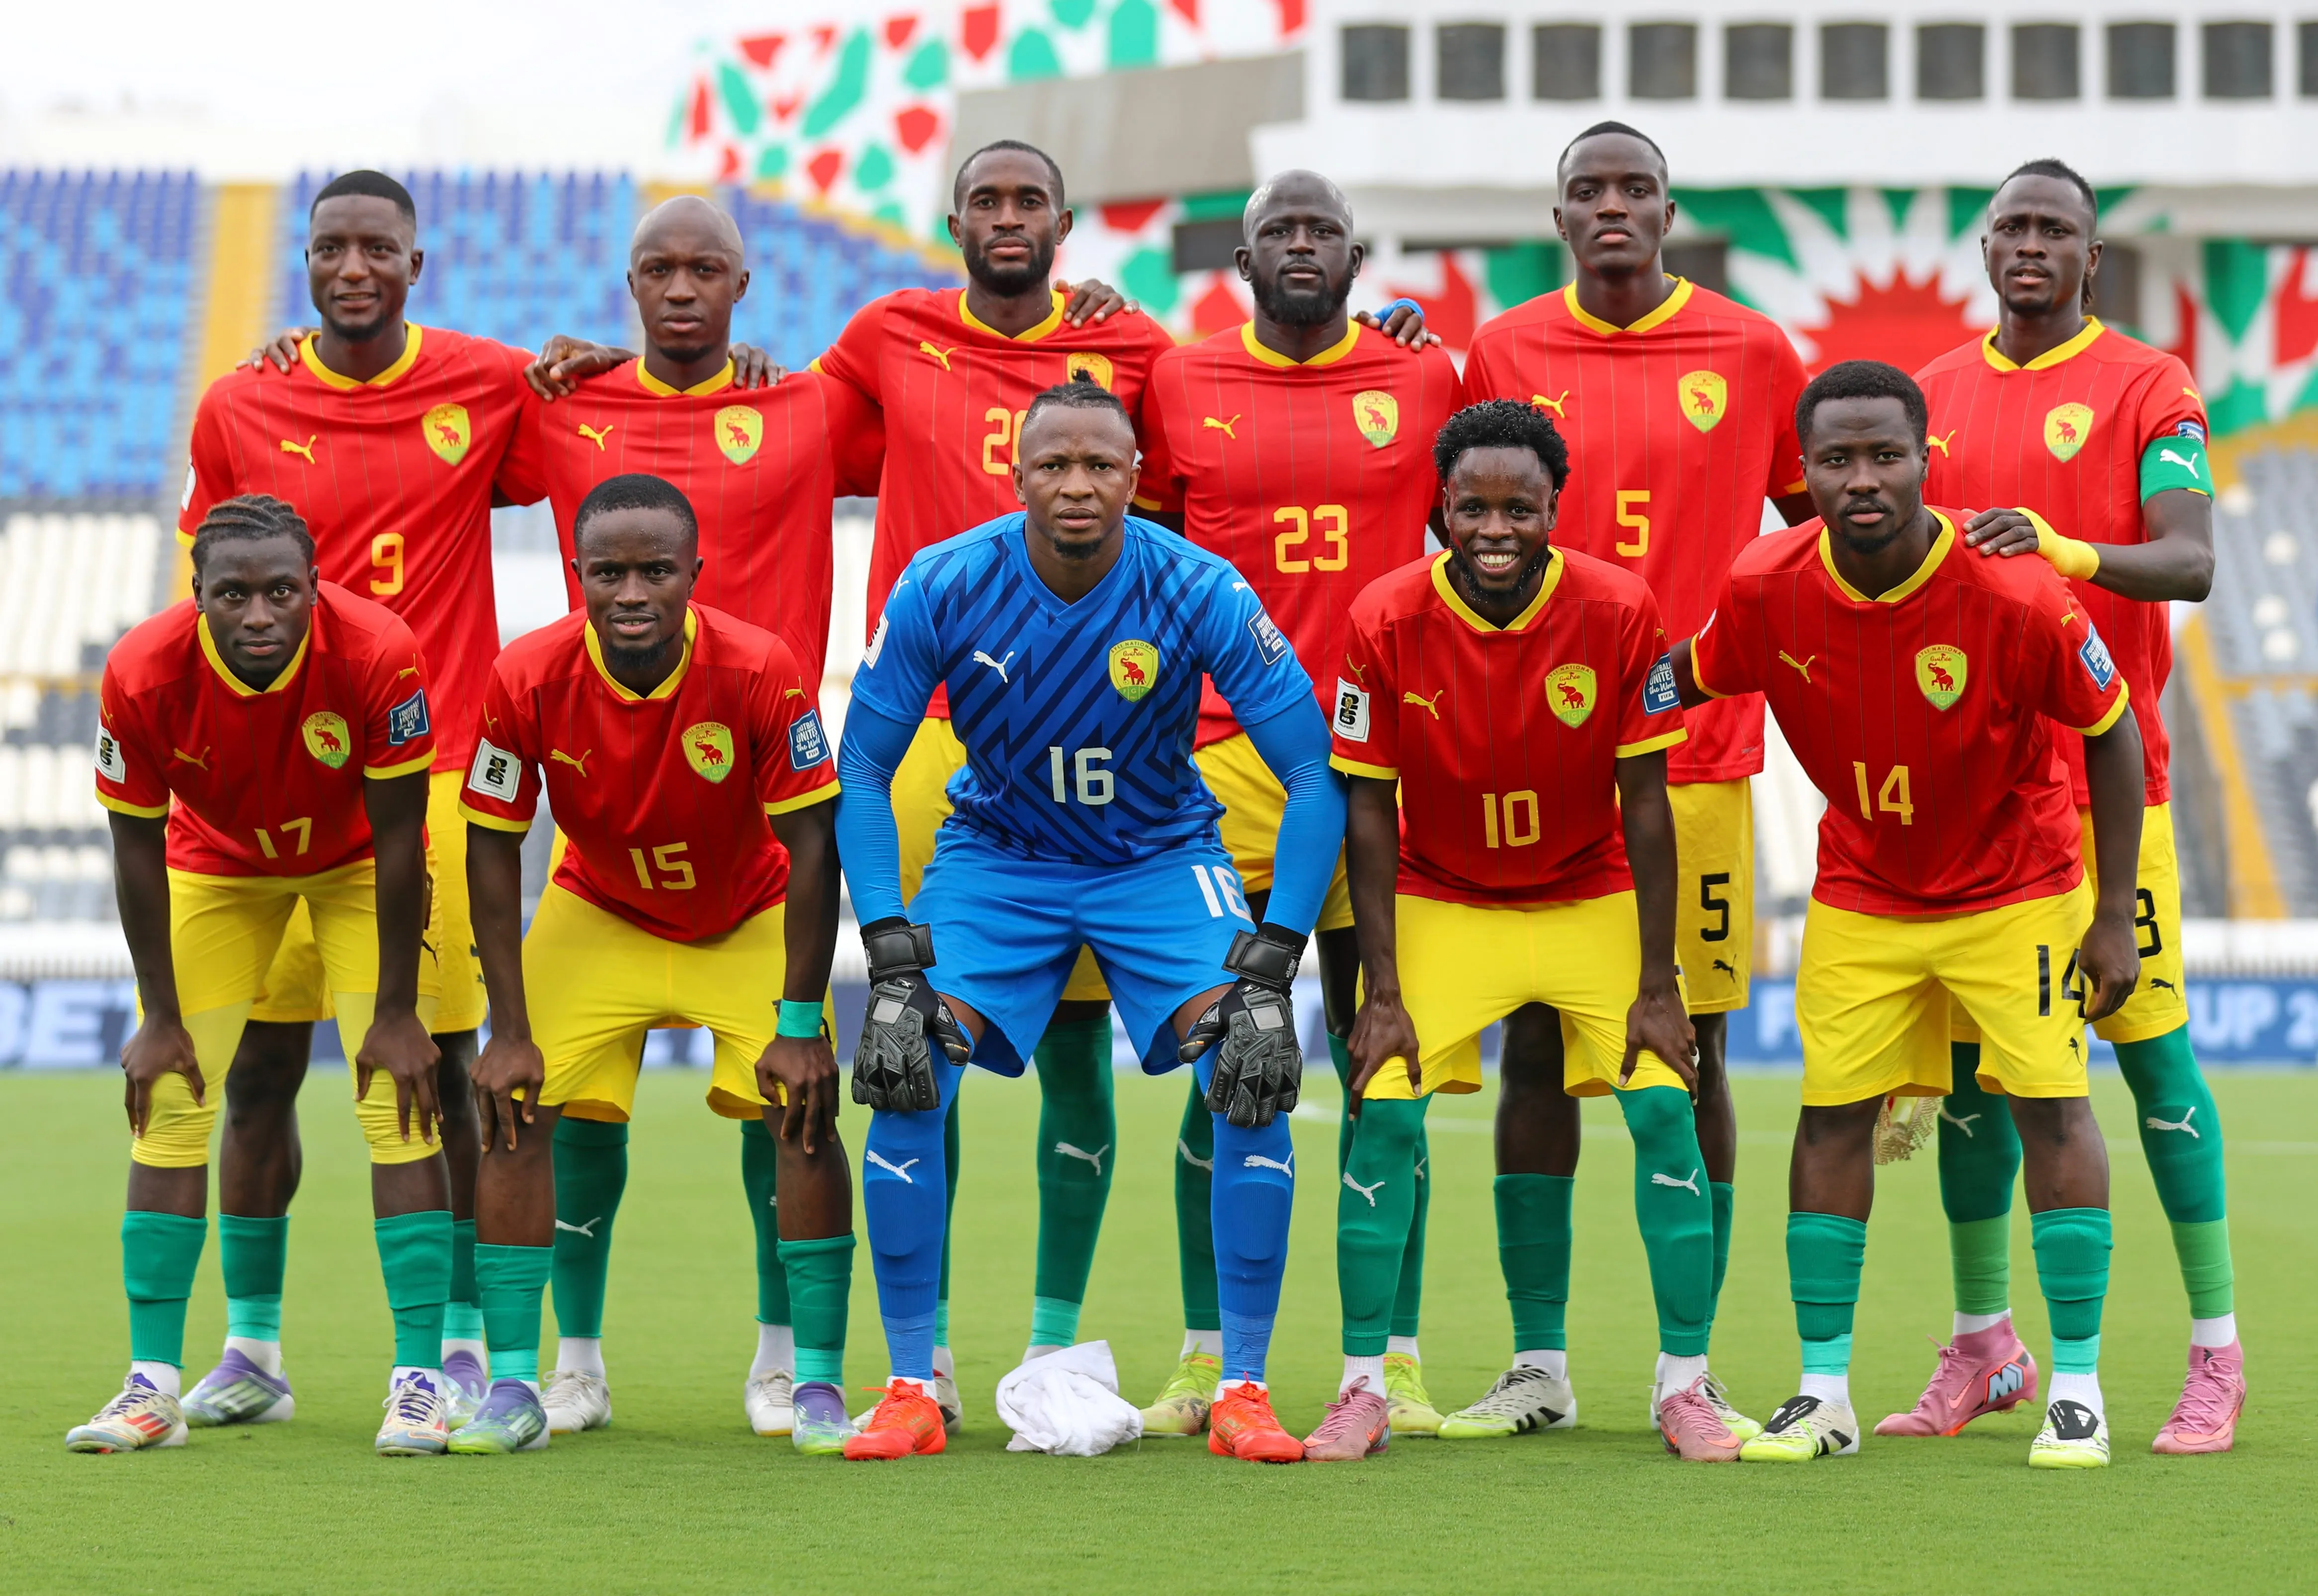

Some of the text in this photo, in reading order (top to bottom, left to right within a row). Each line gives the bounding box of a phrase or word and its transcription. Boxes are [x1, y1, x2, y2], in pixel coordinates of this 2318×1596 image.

[1273, 504, 1348, 573] 23
[1615, 490, 1651, 557] 5
[370, 532, 404, 595] 9
[1125, 641, 1156, 653] NATIONAL
[1560, 665, 1592, 674] NATIONAL
[1932, 646, 1964, 658] NATIONAL
[1648, 684, 1660, 695] the
[1649, 669, 1673, 685] UNITES
[696, 723, 727, 732] NATIONAL
[795, 742, 808, 753] the
[796, 725, 818, 744] UNITES
[1049, 747, 1114, 805] 16
[1853, 761, 1914, 825] 14
[254, 817, 312, 859] 17
[1482, 790, 1540, 848] 10
[629, 841, 696, 890] 15
[1190, 865, 1254, 924] 16
[1700, 872, 1730, 941] 5
[2036, 944, 2086, 1018] 14
